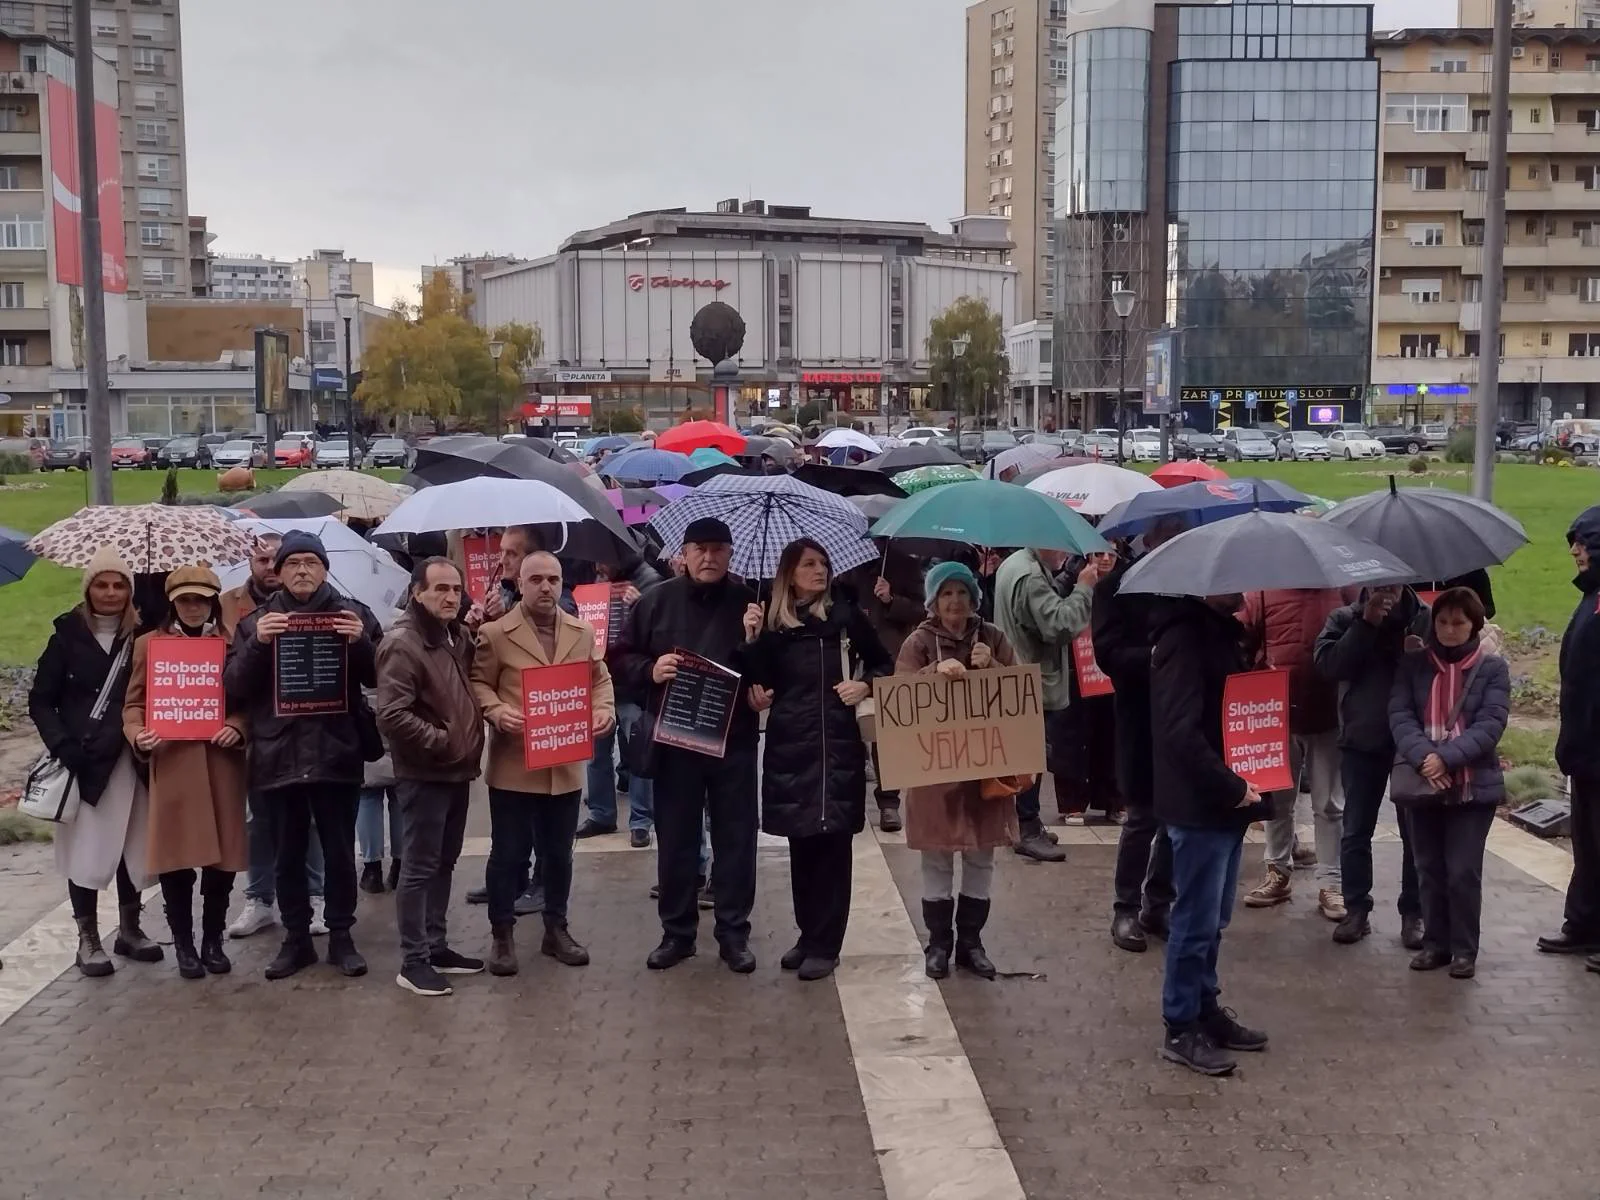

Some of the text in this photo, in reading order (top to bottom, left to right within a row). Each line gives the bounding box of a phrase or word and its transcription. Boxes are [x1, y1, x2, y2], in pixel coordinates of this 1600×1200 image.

[1226, 390, 1288, 399] PRMIUM
[1300, 389, 1332, 398] SLOT
[1056, 492, 1090, 500] VILAN
[154, 661, 220, 673] Sloboda
[154, 674, 219, 689] za ljude,
[153, 696, 219, 706] zatvor za
[528, 685, 587, 704] Sloboda
[878, 673, 1039, 729] КОРУПЦИЈА
[153, 707, 219, 724] neljude!
[529, 699, 587, 717] za ljude,
[1228, 698, 1283, 717] Sloboda
[530, 720, 588, 737] zatvor za
[1229, 714, 1283, 733] za ljude,
[531, 730, 589, 751] neljude!
[917, 726, 1008, 772] УБИЈА
[1230, 741, 1283, 757] zatvor za
[1231, 752, 1285, 775] neljude!
